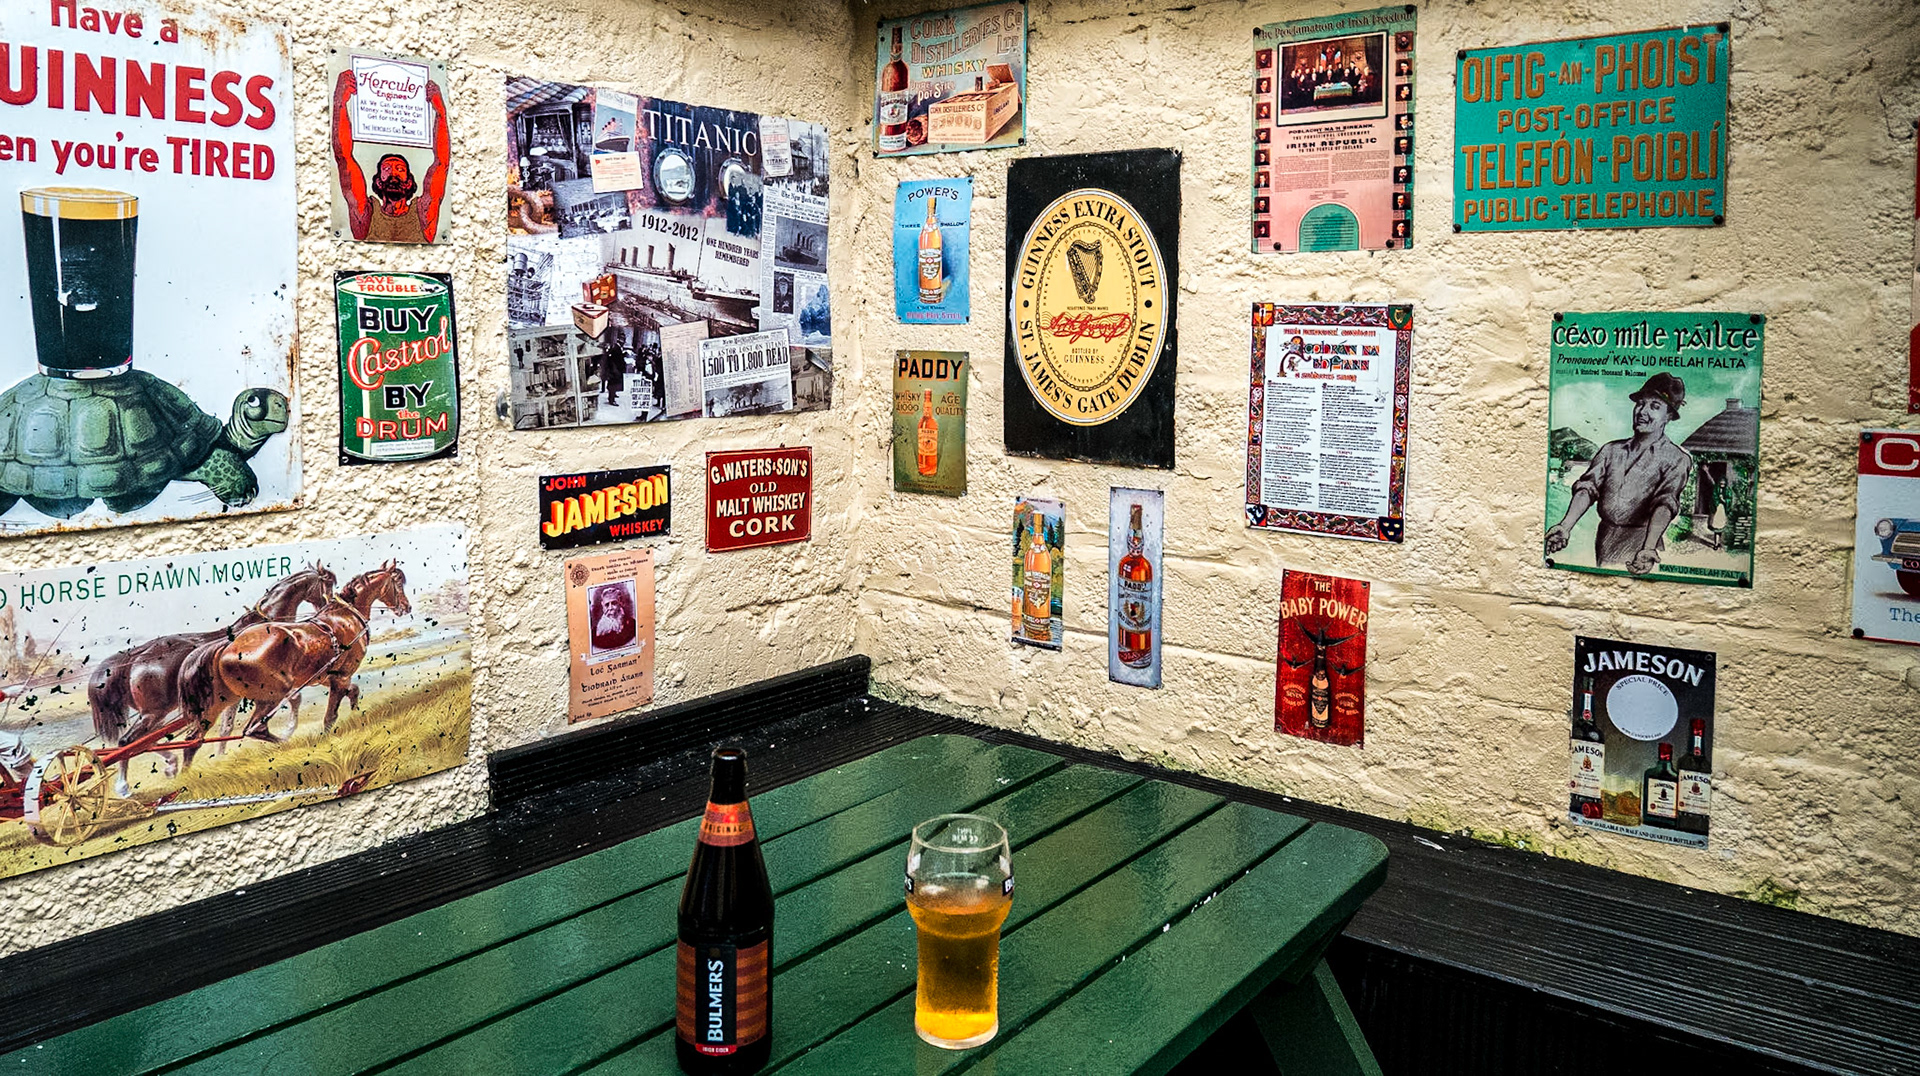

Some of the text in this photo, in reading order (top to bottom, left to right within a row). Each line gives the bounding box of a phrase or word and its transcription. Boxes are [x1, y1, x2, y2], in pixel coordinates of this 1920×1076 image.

[51, 0, 178, 43] Have a
[910, 16, 957, 40] CORK
[1274, 23, 1333, 39] Proclamation
[1336, 21, 1346, 31] of
[1349, 16, 1370, 29] Irish
[1372, 11, 1413, 26] Freedom
[911, 16, 1001, 64] DISTILLERIES
[922, 58, 988, 79] WHISKY
[359, 71, 423, 100] Hercules
[643, 109, 758, 156] TITANIC
[1287, 137, 1377, 149] IRISH REPUBLIC
[51, 132, 159, 175] you're
[167, 136, 275, 180] TIRED
[907, 186, 959, 203] POWER'S
[641, 213, 699, 242] 1912-2012
[706, 237, 759, 259] ONE HUNDRED YEARS
[1022, 201, 1156, 289] GUINNESS EXTRA STOUT
[715, 250, 750, 268] REMEMBERED
[355, 275, 394, 284] SAVE
[358, 284, 418, 293] TROUBLE
[358, 304, 438, 333] BUY
[347, 316, 452, 390] Castrol
[726, 354, 739, 373] TO
[766, 346, 788, 367] DEAD
[1063, 354, 1105, 364] GUINNESS
[1557, 354, 1609, 365] Pronounced
[1659, 356, 1704, 368] MEELAH
[898, 358, 963, 380] PADDY
[1024, 352, 1074, 410] JAMES'S
[1077, 386, 1120, 414] GATE
[1118, 321, 1156, 391] DUBLIN
[383, 380, 433, 410] BY
[895, 390, 960, 404] WHISKY AGE
[356, 412, 448, 440] DRUM
[396, 409, 420, 419] the
[546, 475, 587, 491] JOHN
[749, 481, 777, 494] OLD
[543, 474, 668, 538] JAMESON
[716, 492, 805, 518] MALT WHISKEY
[609, 518, 664, 537] WHISKEY
[729, 514, 796, 538] CORK
[20, 577, 107, 609] HORSE
[118, 567, 201, 596] DRAWN
[212, 556, 292, 583] MOWER
[1659, 564, 1747, 579] KAY-UD MEELAH FALTA
[1314, 580, 1331, 593] THE
[1280, 597, 1367, 631] BABY POWER
[1583, 650, 1706, 687] JAMESON
[1616, 676, 1669, 697] SPECIAL PRICE
[707, 959, 724, 1042] BULMERS
